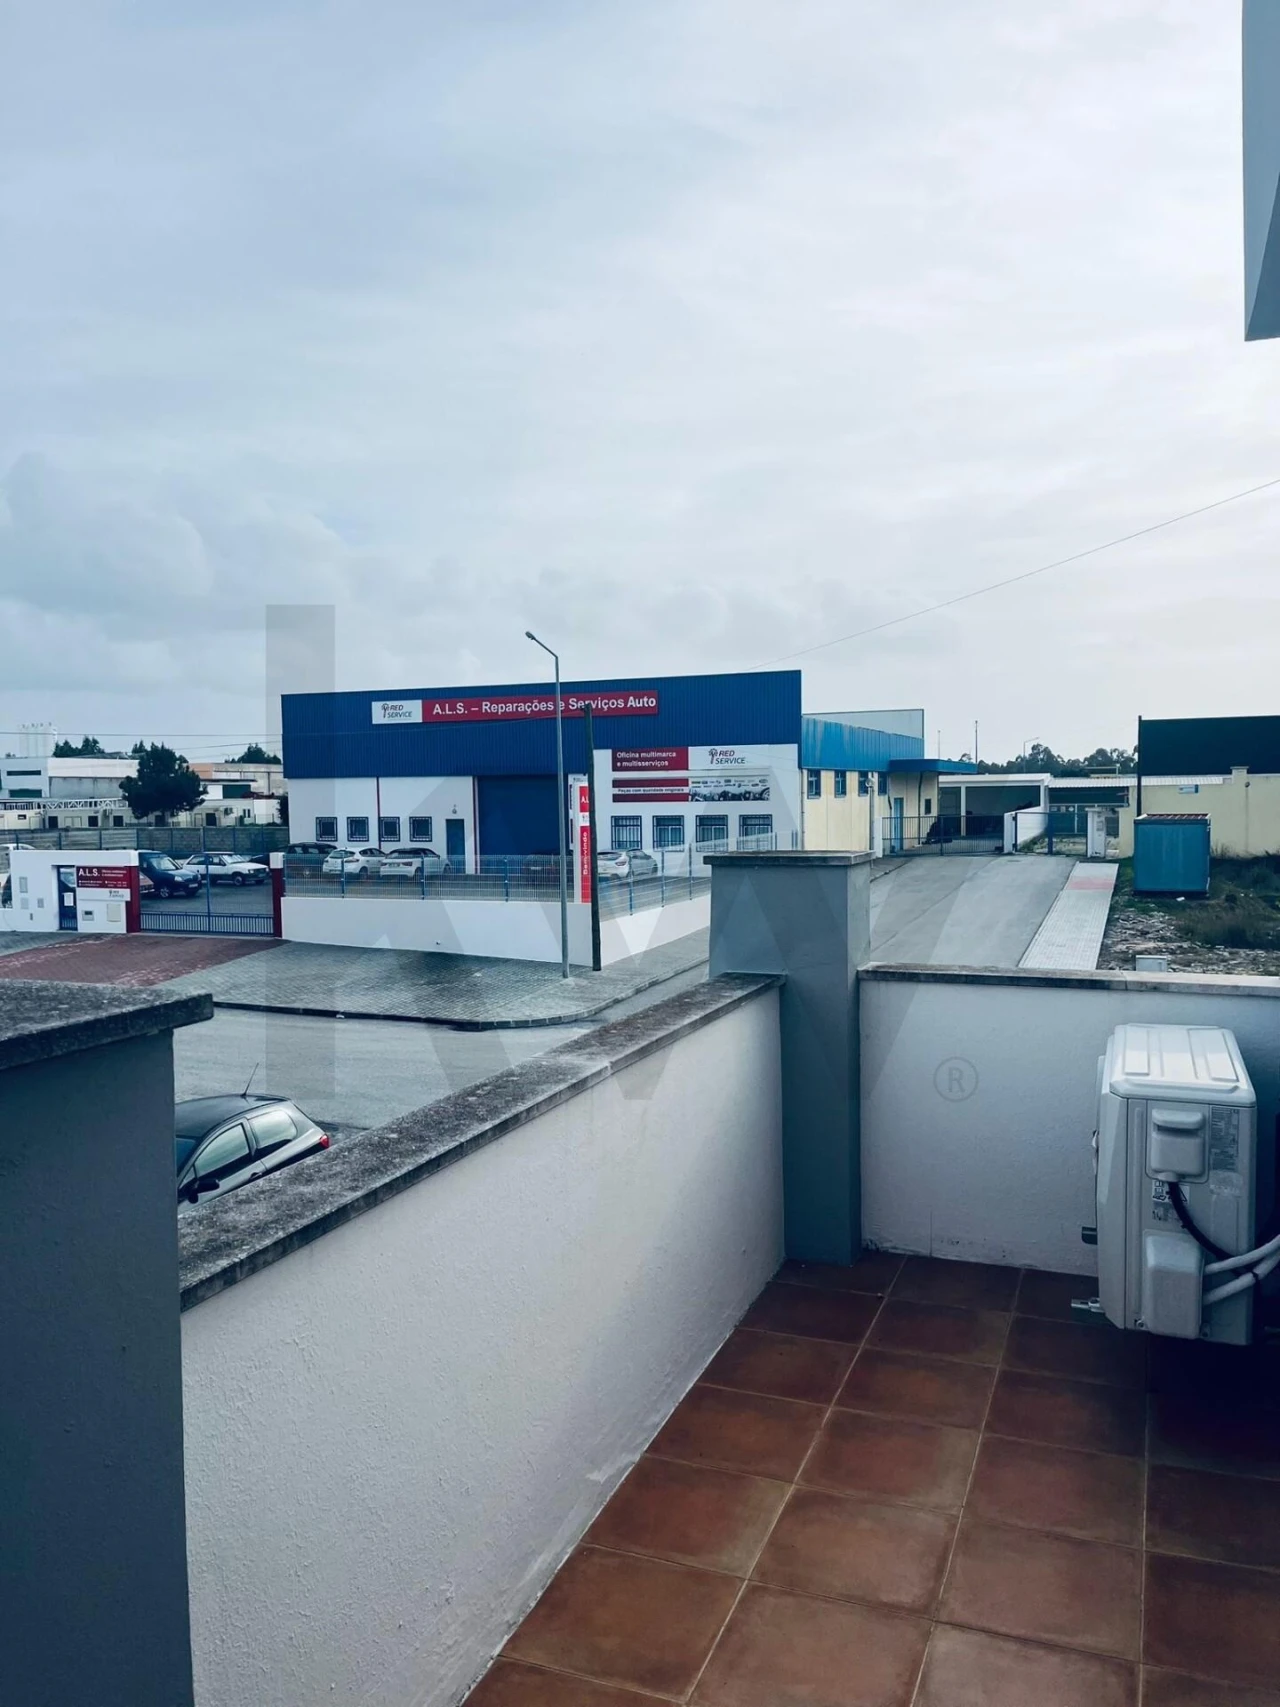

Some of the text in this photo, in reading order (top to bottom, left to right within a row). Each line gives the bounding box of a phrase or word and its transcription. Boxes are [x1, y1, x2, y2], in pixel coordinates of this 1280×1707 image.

[390, 703, 404, 711] RED
[433, 702, 468, 715] A.L.S.
[482, 699, 554, 715] Reparações
[558, 700, 565, 711] e
[568, 697, 625, 712] Serviços
[626, 695, 657, 708] Auto
[616, 751, 640, 759] Oficina
[718, 749, 736, 757] RED
[622, 759, 669, 768] multisserviços
[715, 756, 746, 765] SERVICE
[78, 867, 101, 877] A.L.S.
